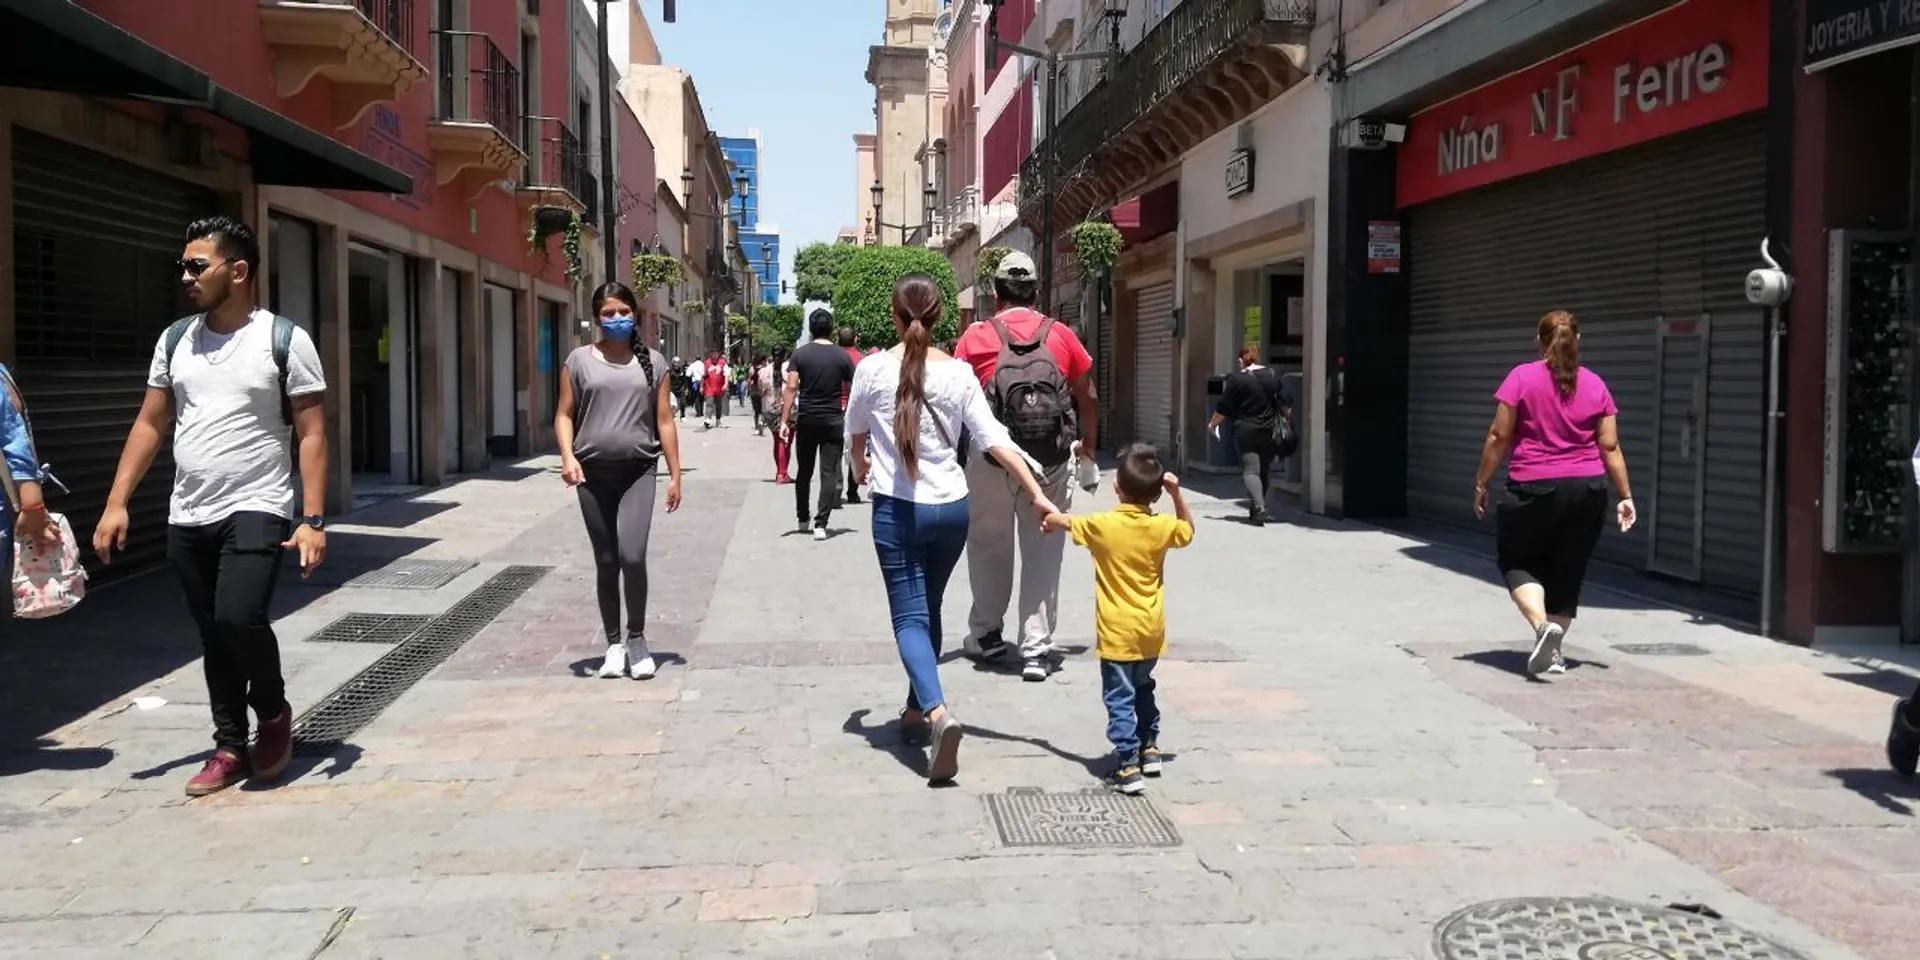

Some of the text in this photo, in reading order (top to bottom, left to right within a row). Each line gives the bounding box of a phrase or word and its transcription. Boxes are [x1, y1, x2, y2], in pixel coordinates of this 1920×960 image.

[1807, 7, 1873, 55] JOYERIA
[1878, 0, 1890, 32] Y
[1613, 43, 1725, 124] Ferre
[1359, 123, 1385, 137] BETA
